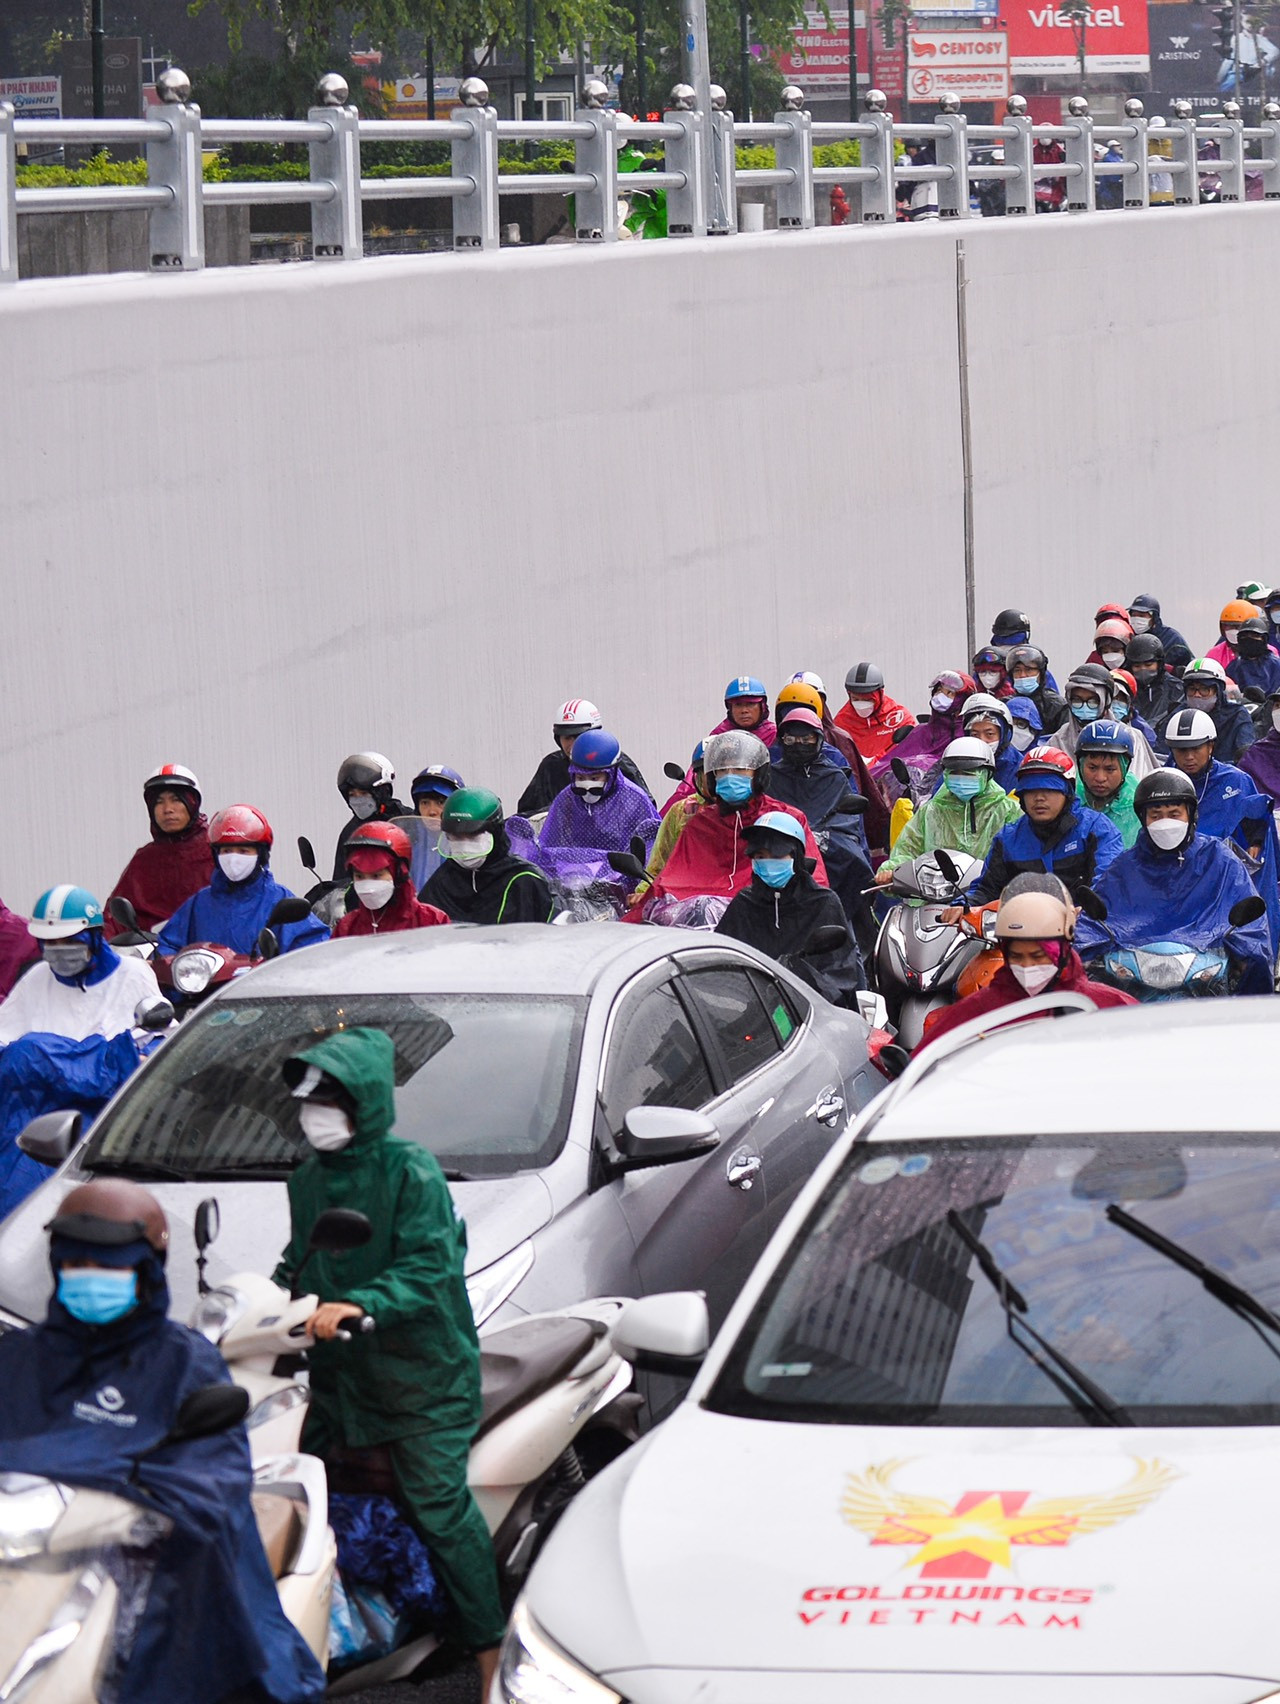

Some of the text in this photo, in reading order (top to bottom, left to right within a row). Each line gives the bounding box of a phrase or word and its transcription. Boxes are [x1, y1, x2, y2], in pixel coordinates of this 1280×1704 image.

[939, 41, 1003, 55] CENTOSY
[1158, 51, 1200, 61] ARISTINO
[801, 1585, 1095, 1605] GOLDWINGS
[797, 1608, 1081, 1630] VIETNAM
